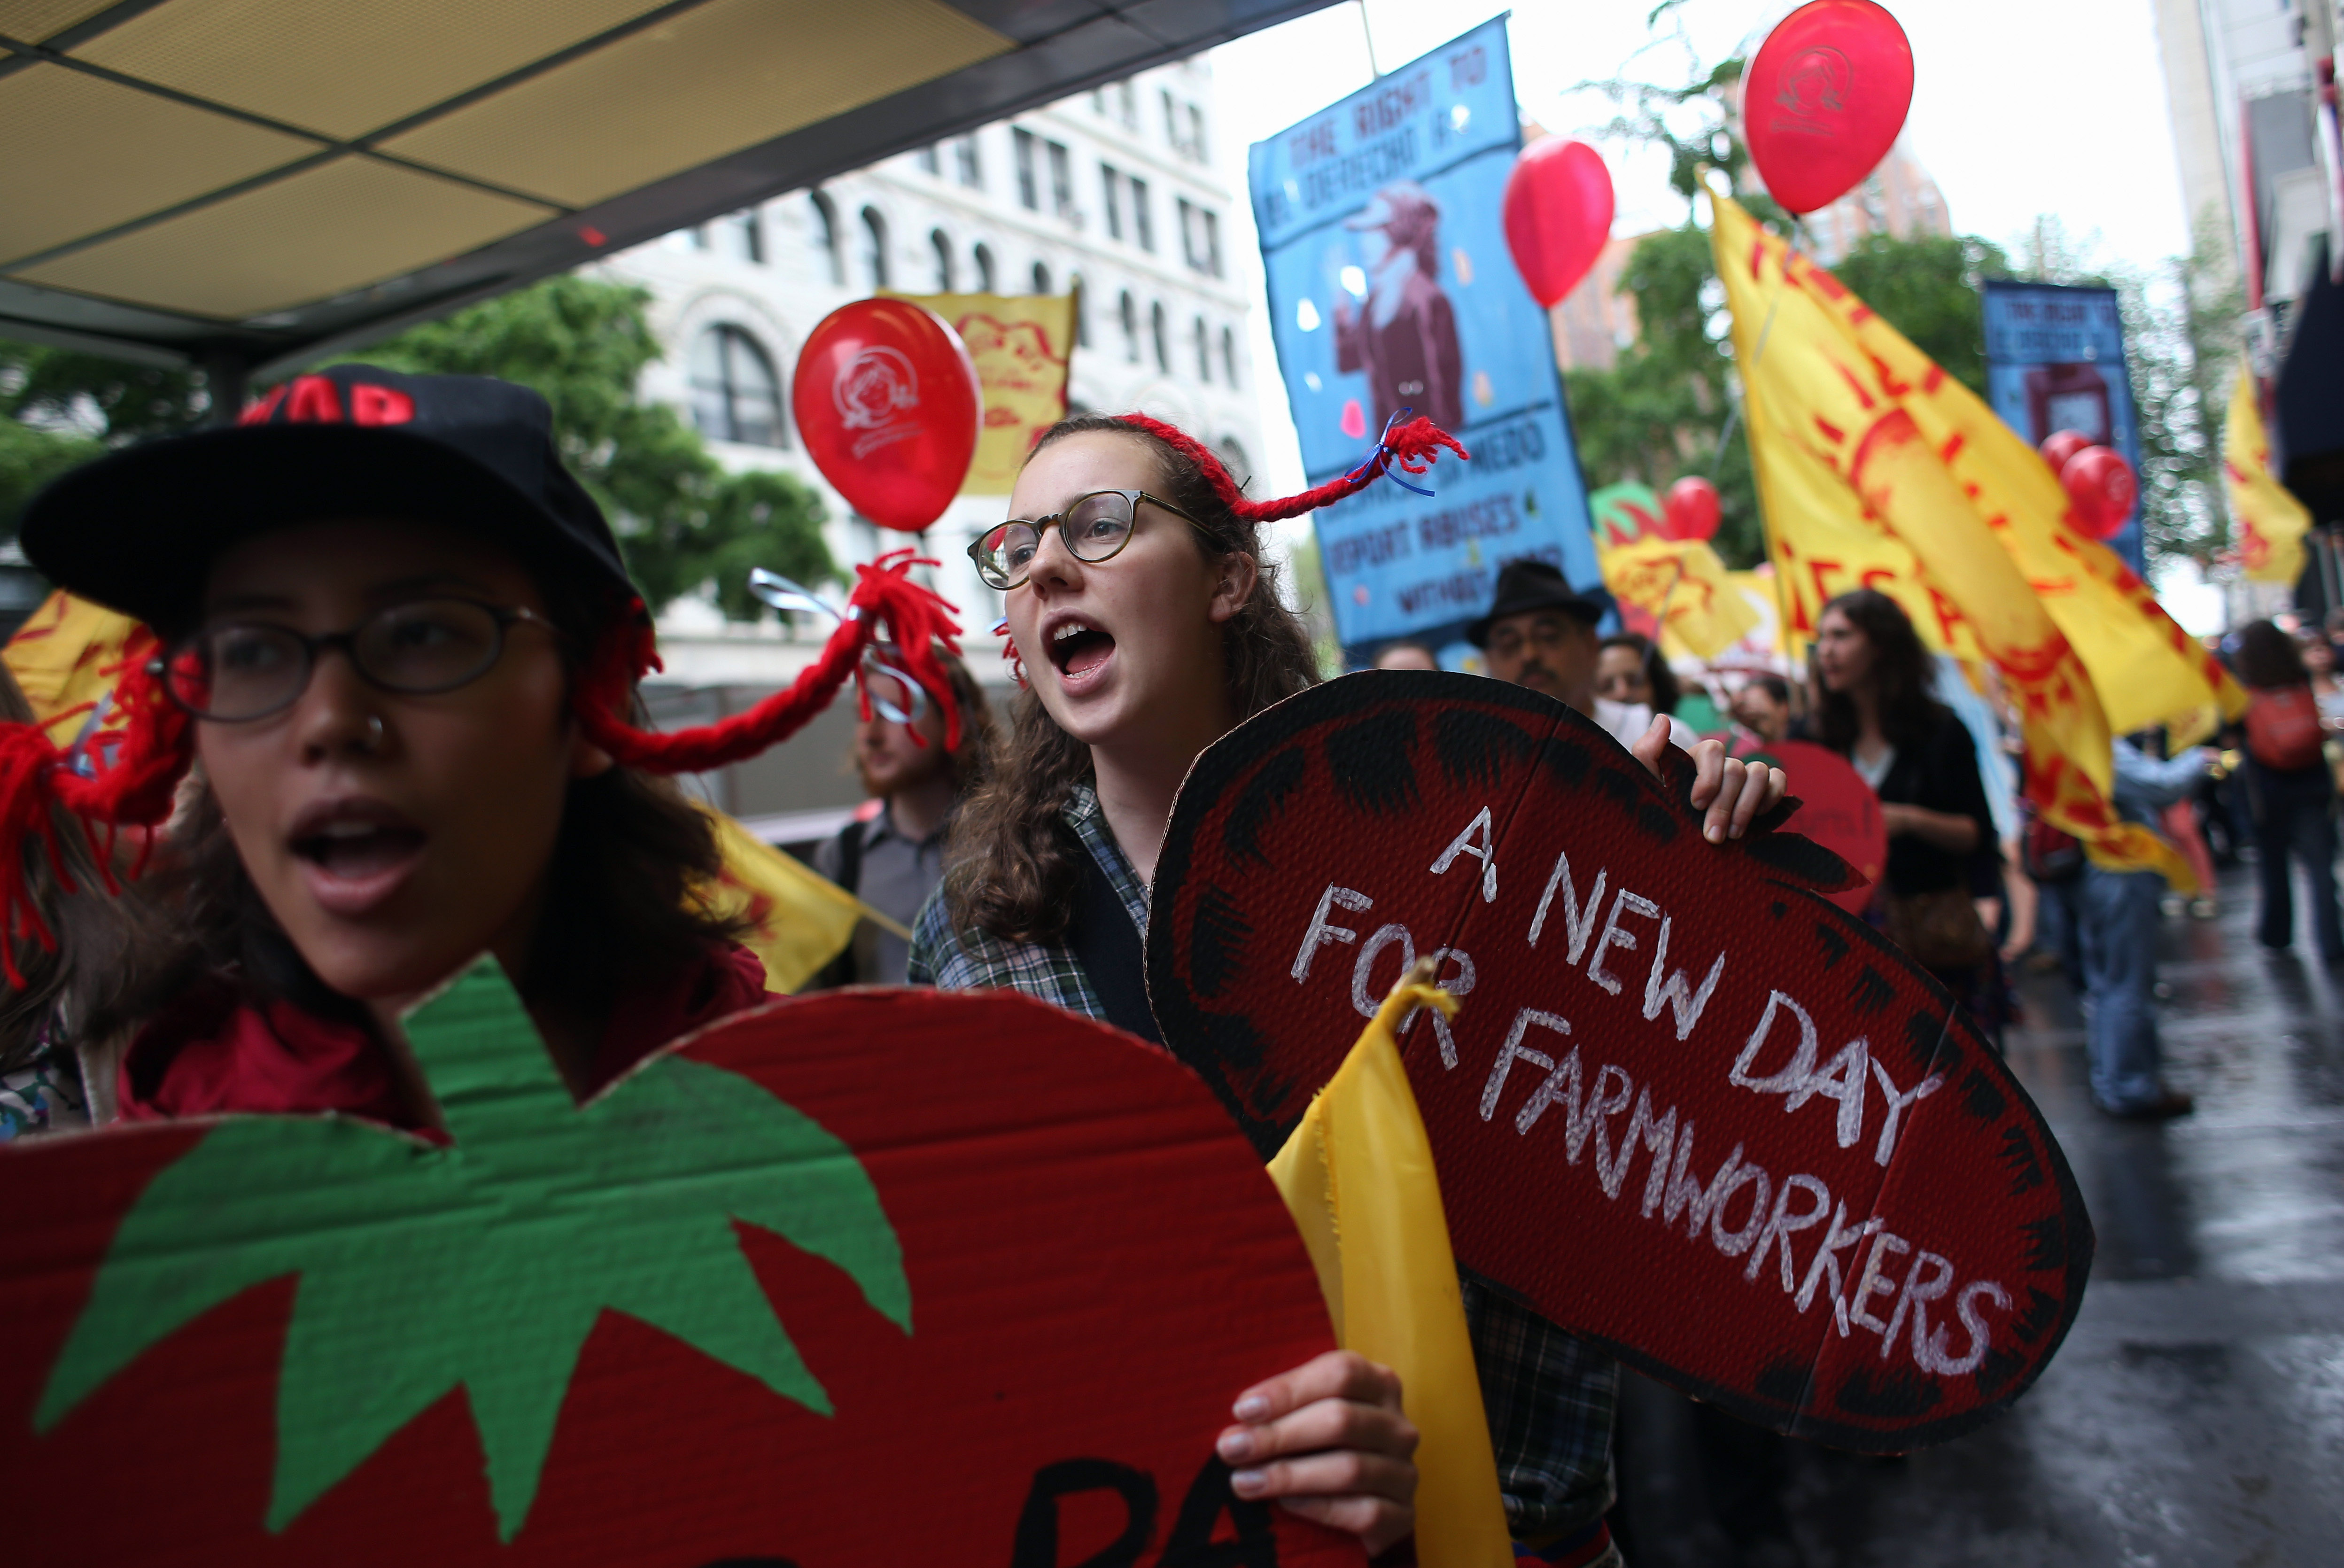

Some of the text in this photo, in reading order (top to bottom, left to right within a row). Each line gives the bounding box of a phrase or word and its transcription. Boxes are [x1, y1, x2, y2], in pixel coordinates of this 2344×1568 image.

[1290, 882, 2014, 1377] FOR FARMWORKERS
[1429, 806, 1947, 1167] A NEW DAY
